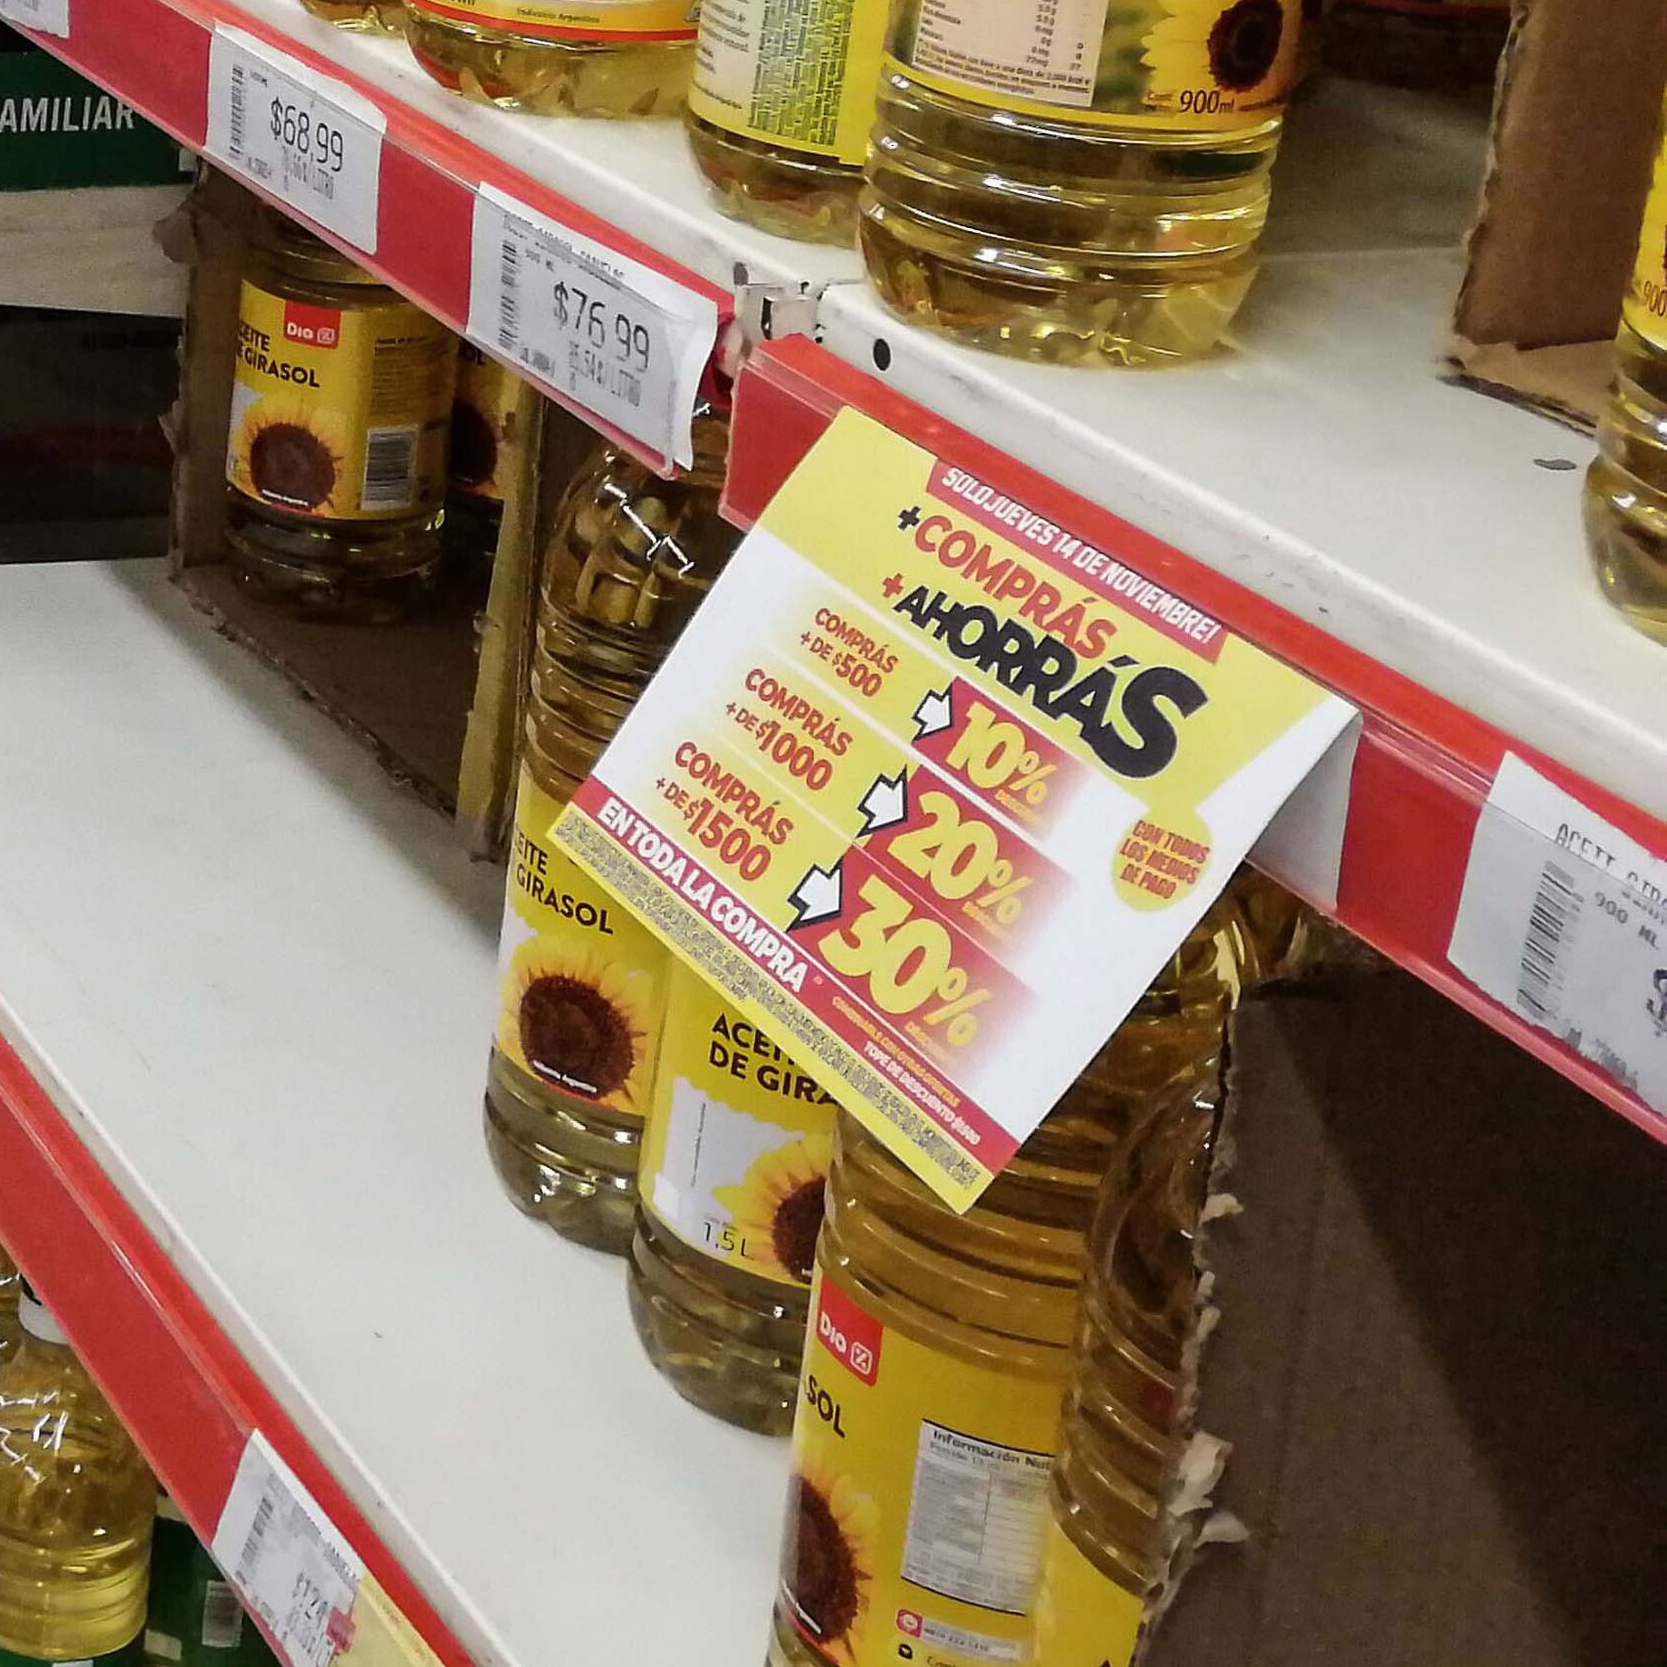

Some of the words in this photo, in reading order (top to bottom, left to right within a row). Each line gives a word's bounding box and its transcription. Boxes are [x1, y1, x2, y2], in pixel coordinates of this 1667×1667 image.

[244, 348, 320, 388] GIRASOL
[941, 465, 993, 505] SOLO
[983, 492, 1059, 547] JUEVES
[1053, 533, 1077, 559] 14
[1073, 543, 1108, 576] DE
[1101, 559, 1221, 644] NOVIEMBRE!
[810, 636, 833, 661] DE
[832, 651, 883, 697] $500
[815, 608, 898, 674] COMPRÁS
[745, 668, 853, 756] COMPRÁS
[735, 708, 758, 732] DE
[756, 719, 832, 791] $1000
[947, 701, 1058, 804] 10%
[675, 741, 794, 845] COMPRÁS
[663, 782, 689, 810] DE
[683, 797, 771, 881] $1500
[887, 791, 1034, 925] 20%
[1133, 820, 1164, 845] CON
[1164, 832, 1210, 864] TODOS
[517, 864, 614, 935] GIRASOL
[597, 797, 634, 836] EN
[628, 821, 689, 887] TODA
[682, 869, 716, 911] LA
[711, 896, 808, 993] COMPRA
[1120, 864, 1141, 884] DE
[1139, 871, 1177, 899] PAGO
[1595, 891, 1628, 924] 900
[818, 874, 992, 1046] 30%
[709, 1041, 749, 1080] DE
[819, 1310, 847, 1353] Dia
[805, 1374, 845, 1438] SOL
[933, 1429, 1020, 1464] Información
